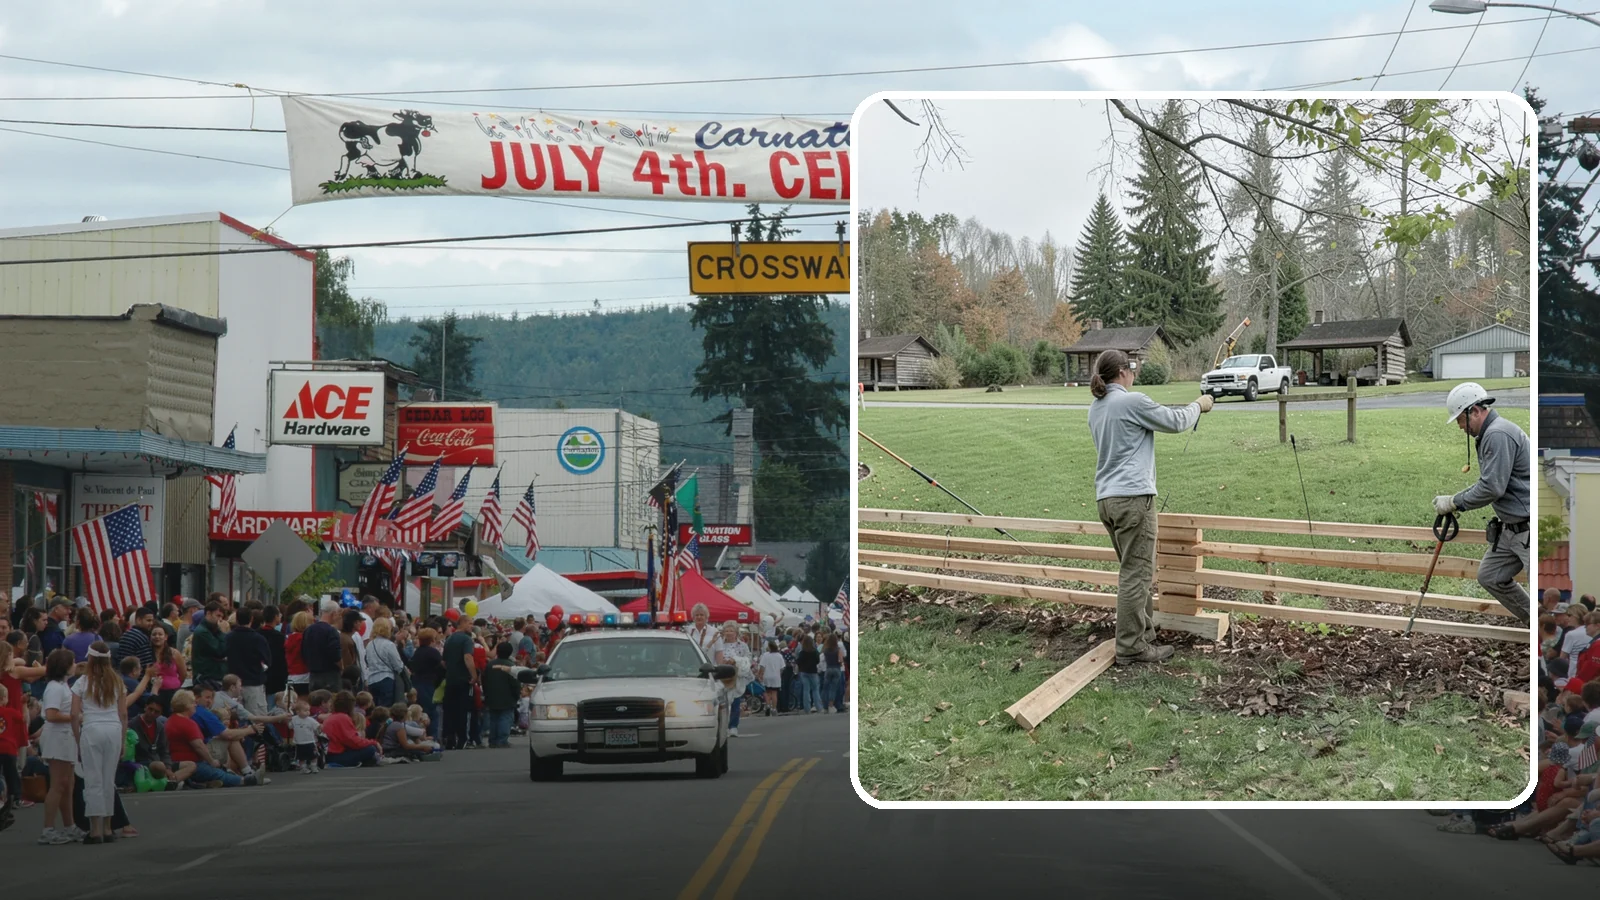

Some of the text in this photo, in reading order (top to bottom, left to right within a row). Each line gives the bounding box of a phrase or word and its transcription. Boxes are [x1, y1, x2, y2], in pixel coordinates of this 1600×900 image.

[695, 121, 850, 150] Carnat
[481, 141, 605, 193] JULY
[632, 150, 746, 198] 4th.
[697, 254, 850, 280] CROSSWA
[282, 380, 374, 420] ACE
[406, 409, 453, 422] CEDAR
[283, 421, 371, 437] Hardware
[83, 485, 155, 495] St. Vincent de Paul
[212, 515, 331, 535] HARDARE
[688, 526, 741, 535] CRNATION
[699, 535, 730, 543] GLASS
